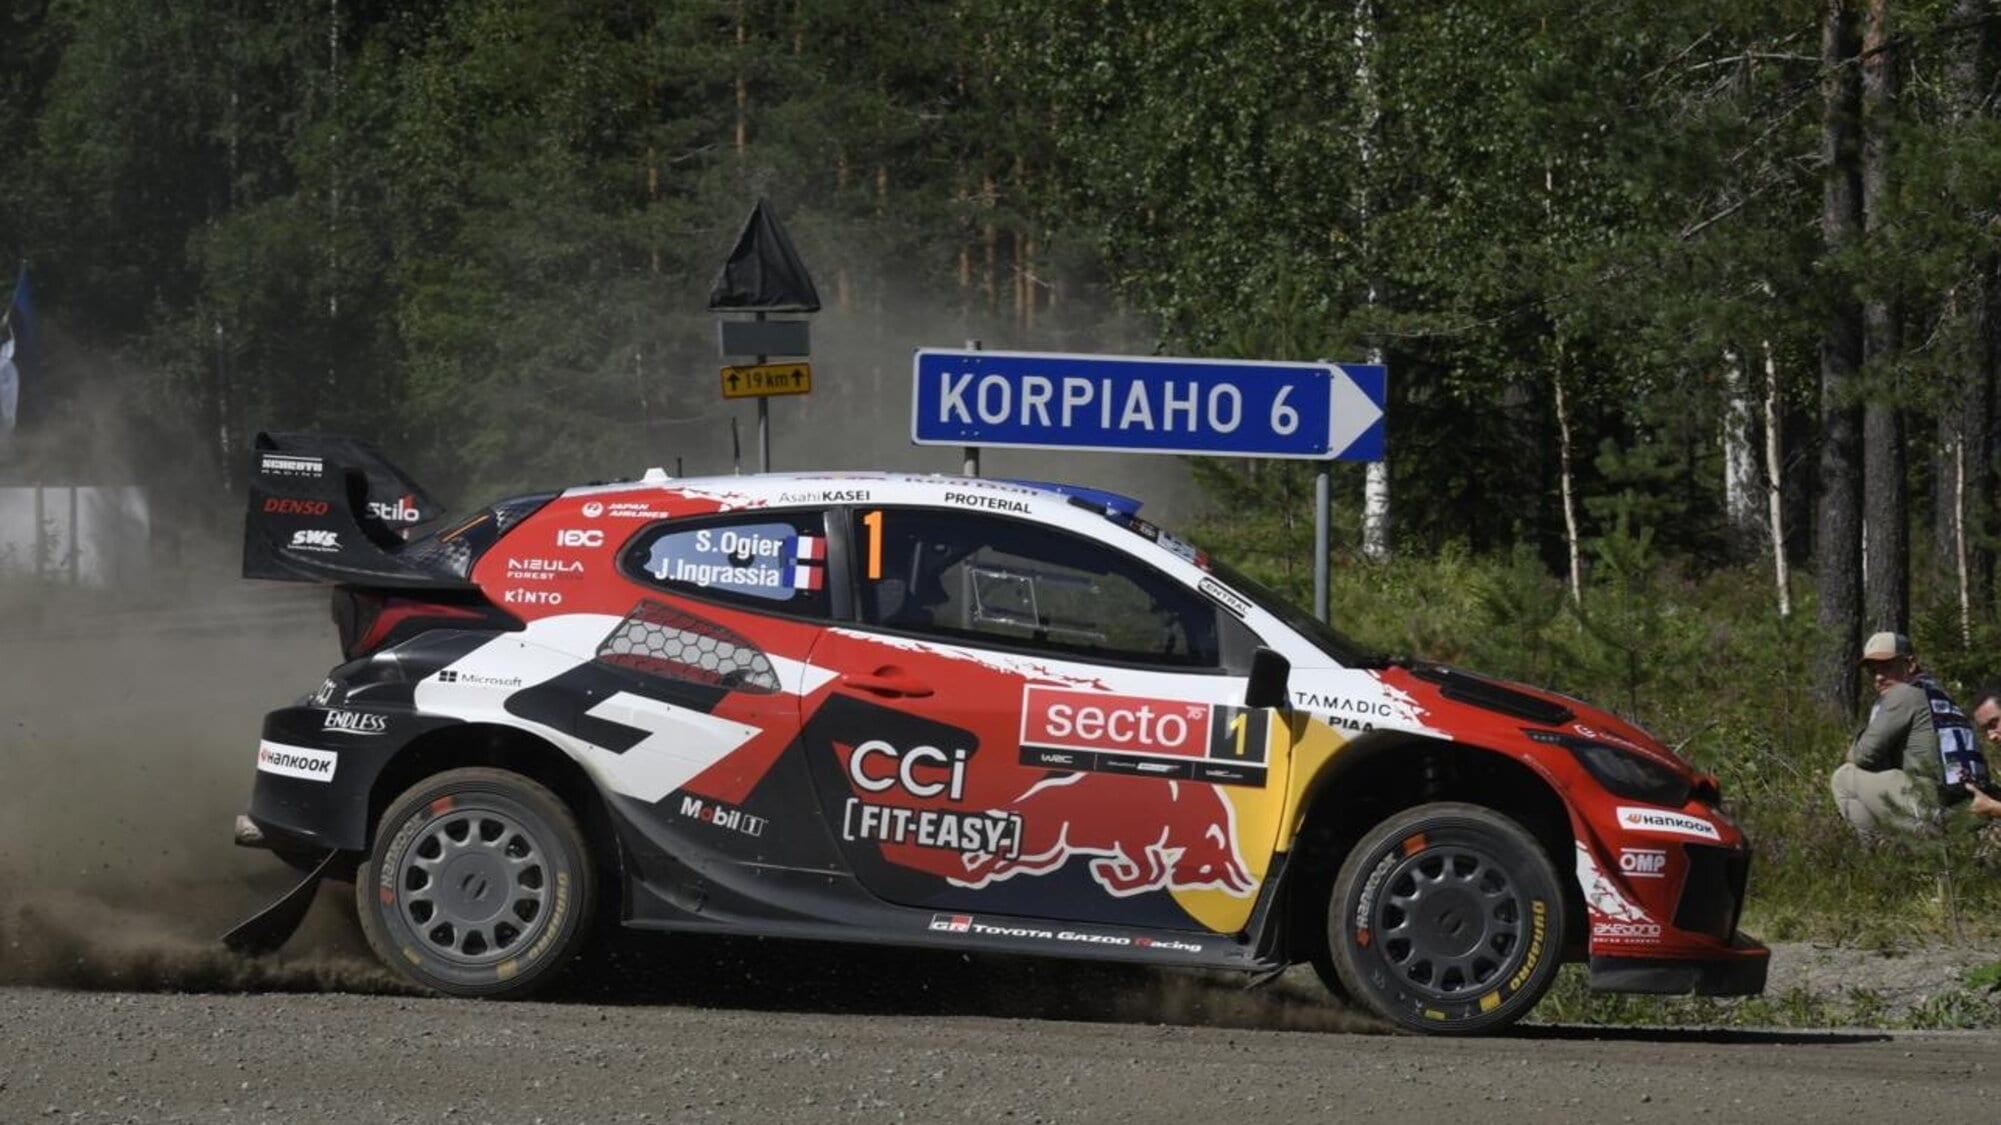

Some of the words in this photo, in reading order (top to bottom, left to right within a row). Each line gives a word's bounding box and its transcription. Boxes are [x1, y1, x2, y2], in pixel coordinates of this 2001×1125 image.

[745, 371, 762, 389] 19
[765, 371, 789, 387] km
[939, 372, 1243, 433] KORPIAHO
[1269, 385, 1299, 435] 6
[264, 498, 329, 516] DENSO
[944, 491, 1032, 514] PROTERIAL
[609, 511, 669, 519] AIRLINES
[863, 510, 883, 580] 1
[507, 572, 555, 580] FOREST
[462, 674, 522, 687] Microsoft
[1296, 692, 1392, 716] TAMADIC
[324, 710, 388, 731] ENDLESS
[1046, 703, 1188, 747] secto
[1328, 716, 1374, 732] PIAA
[1230, 713, 1248, 755] 1
[680, 796, 742, 830] Mobil
[1619, 853, 1666, 872] OMP
[931, 921, 970, 932] GR
[972, 924, 1052, 938] TOYOTA
[1134, 938, 1202, 952] Racing
